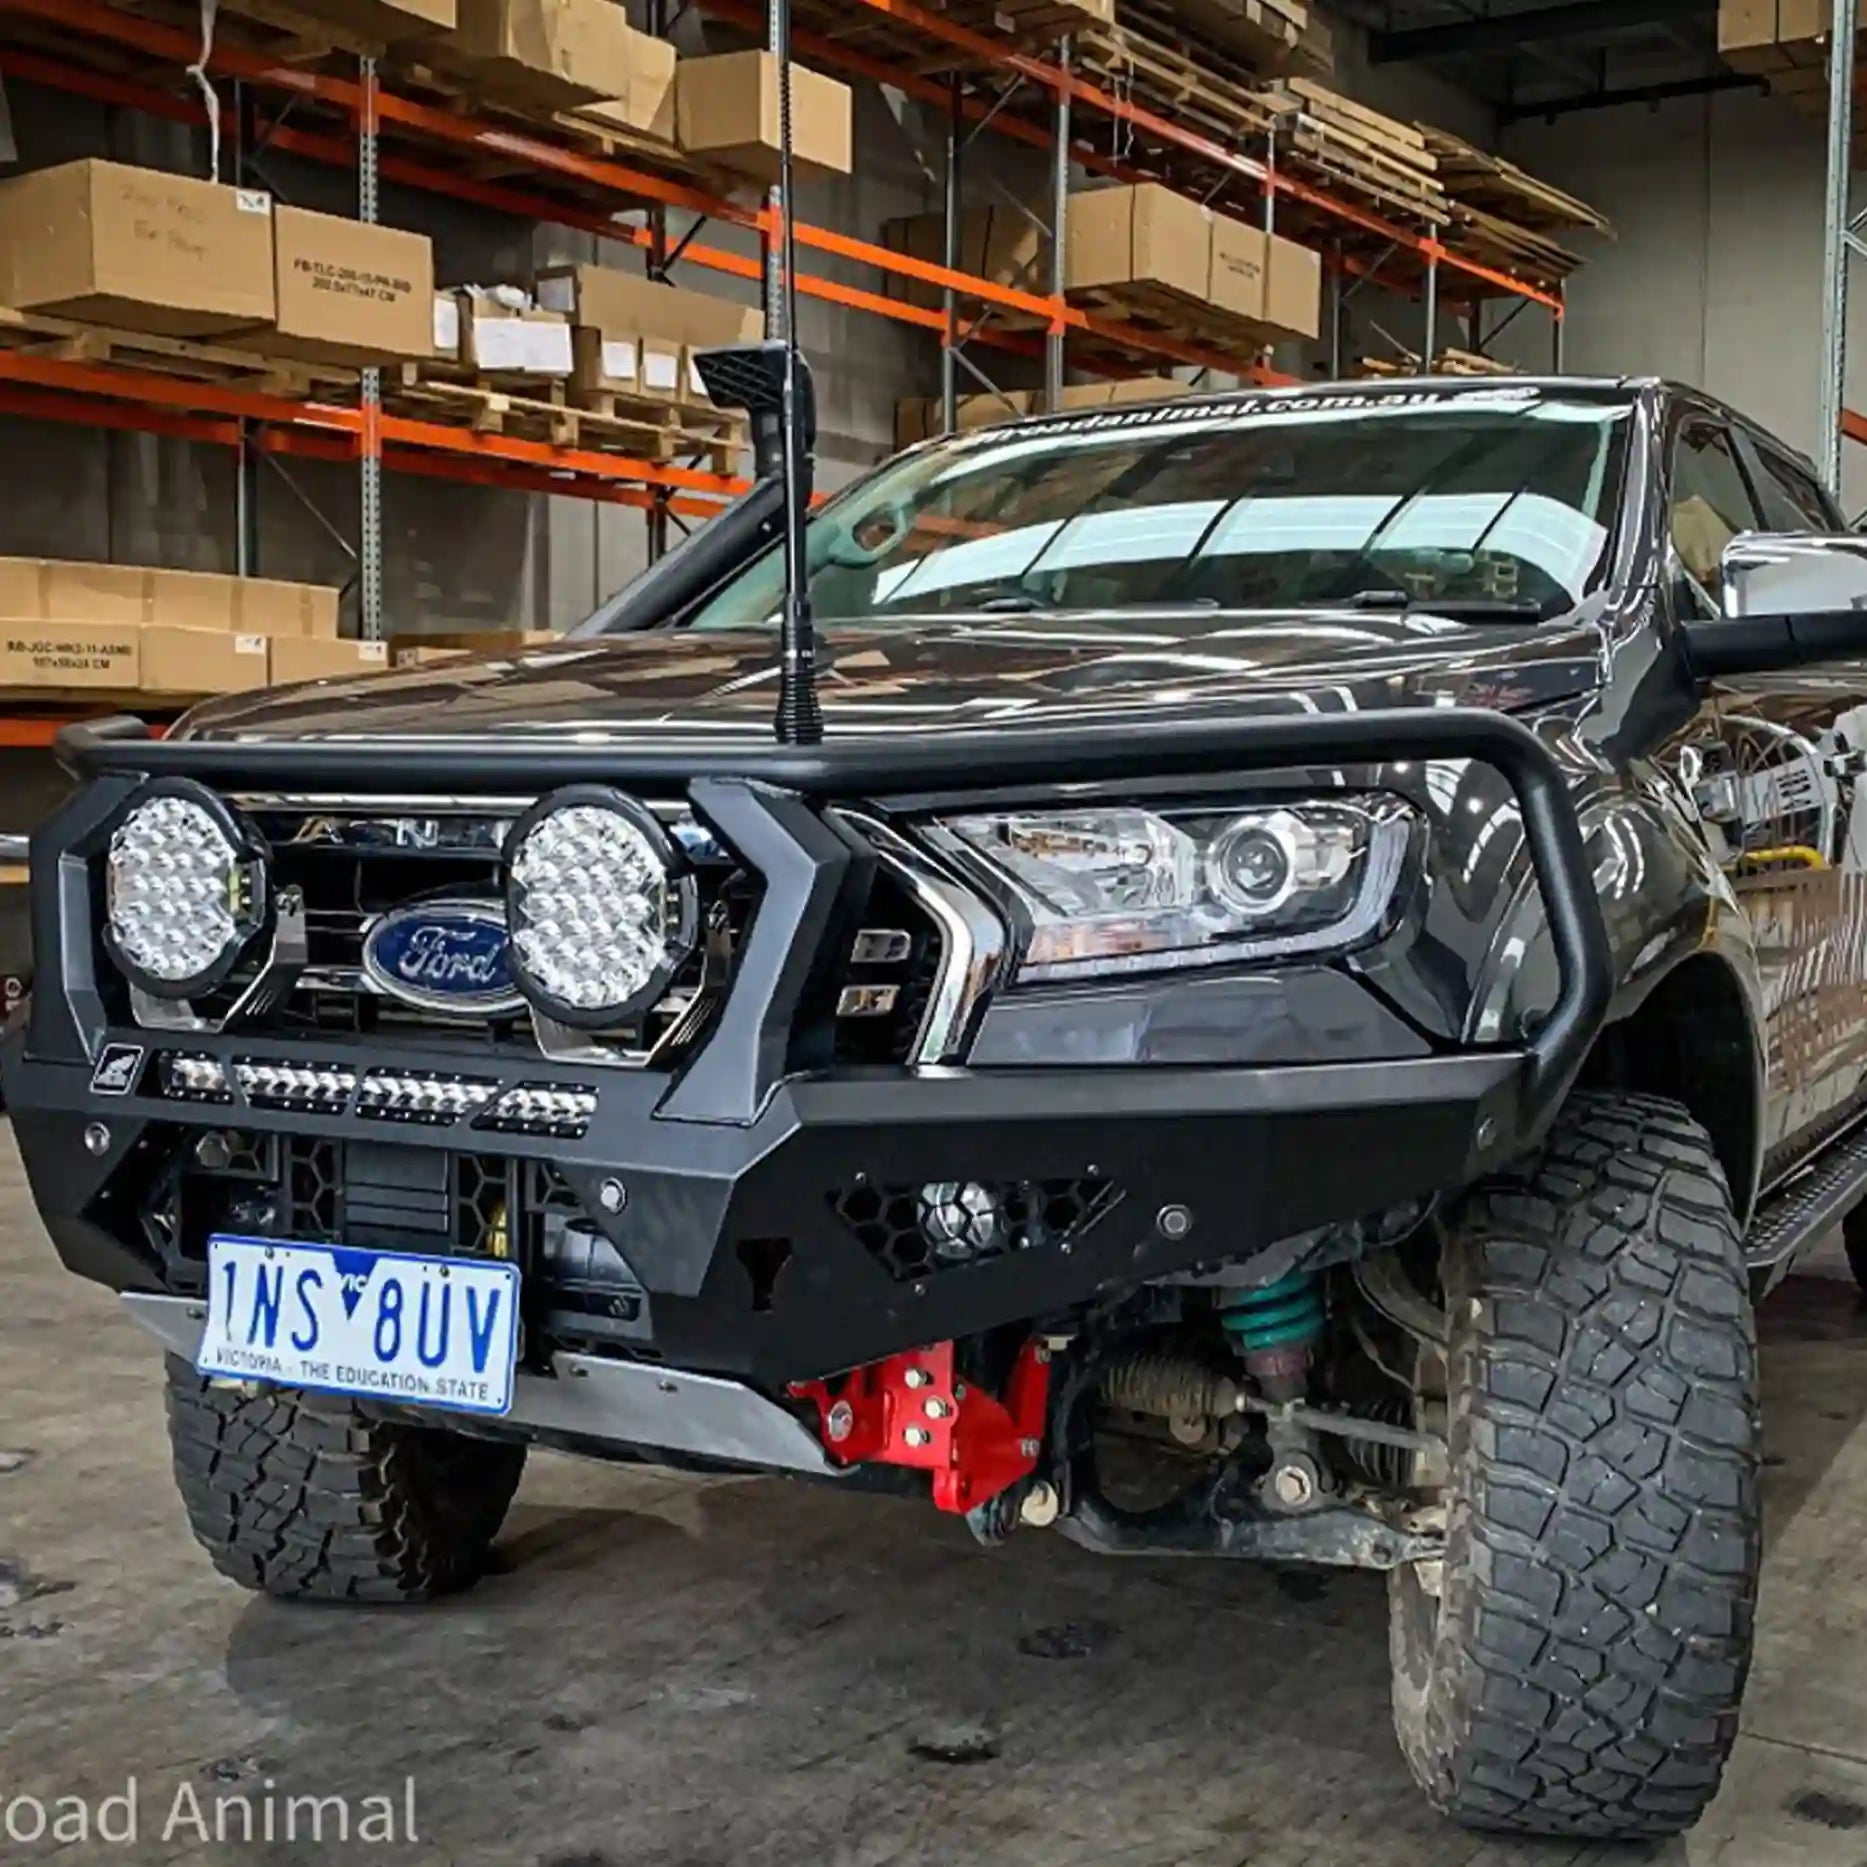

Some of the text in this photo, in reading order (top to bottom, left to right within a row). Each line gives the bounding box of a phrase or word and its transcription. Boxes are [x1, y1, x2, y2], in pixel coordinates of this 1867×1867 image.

[378, 289, 396, 303] CM
[92, 658, 110, 670] CM
[399, 924, 499, 982] Ford
[222, 1260, 502, 1375] 1NS 8UV
[216, 1346, 283, 1374] VICTORIA
[300, 1360, 330, 1381] THE
[336, 1365, 429, 1393] EDUCATION
[435, 1379, 489, 1400] STATE
